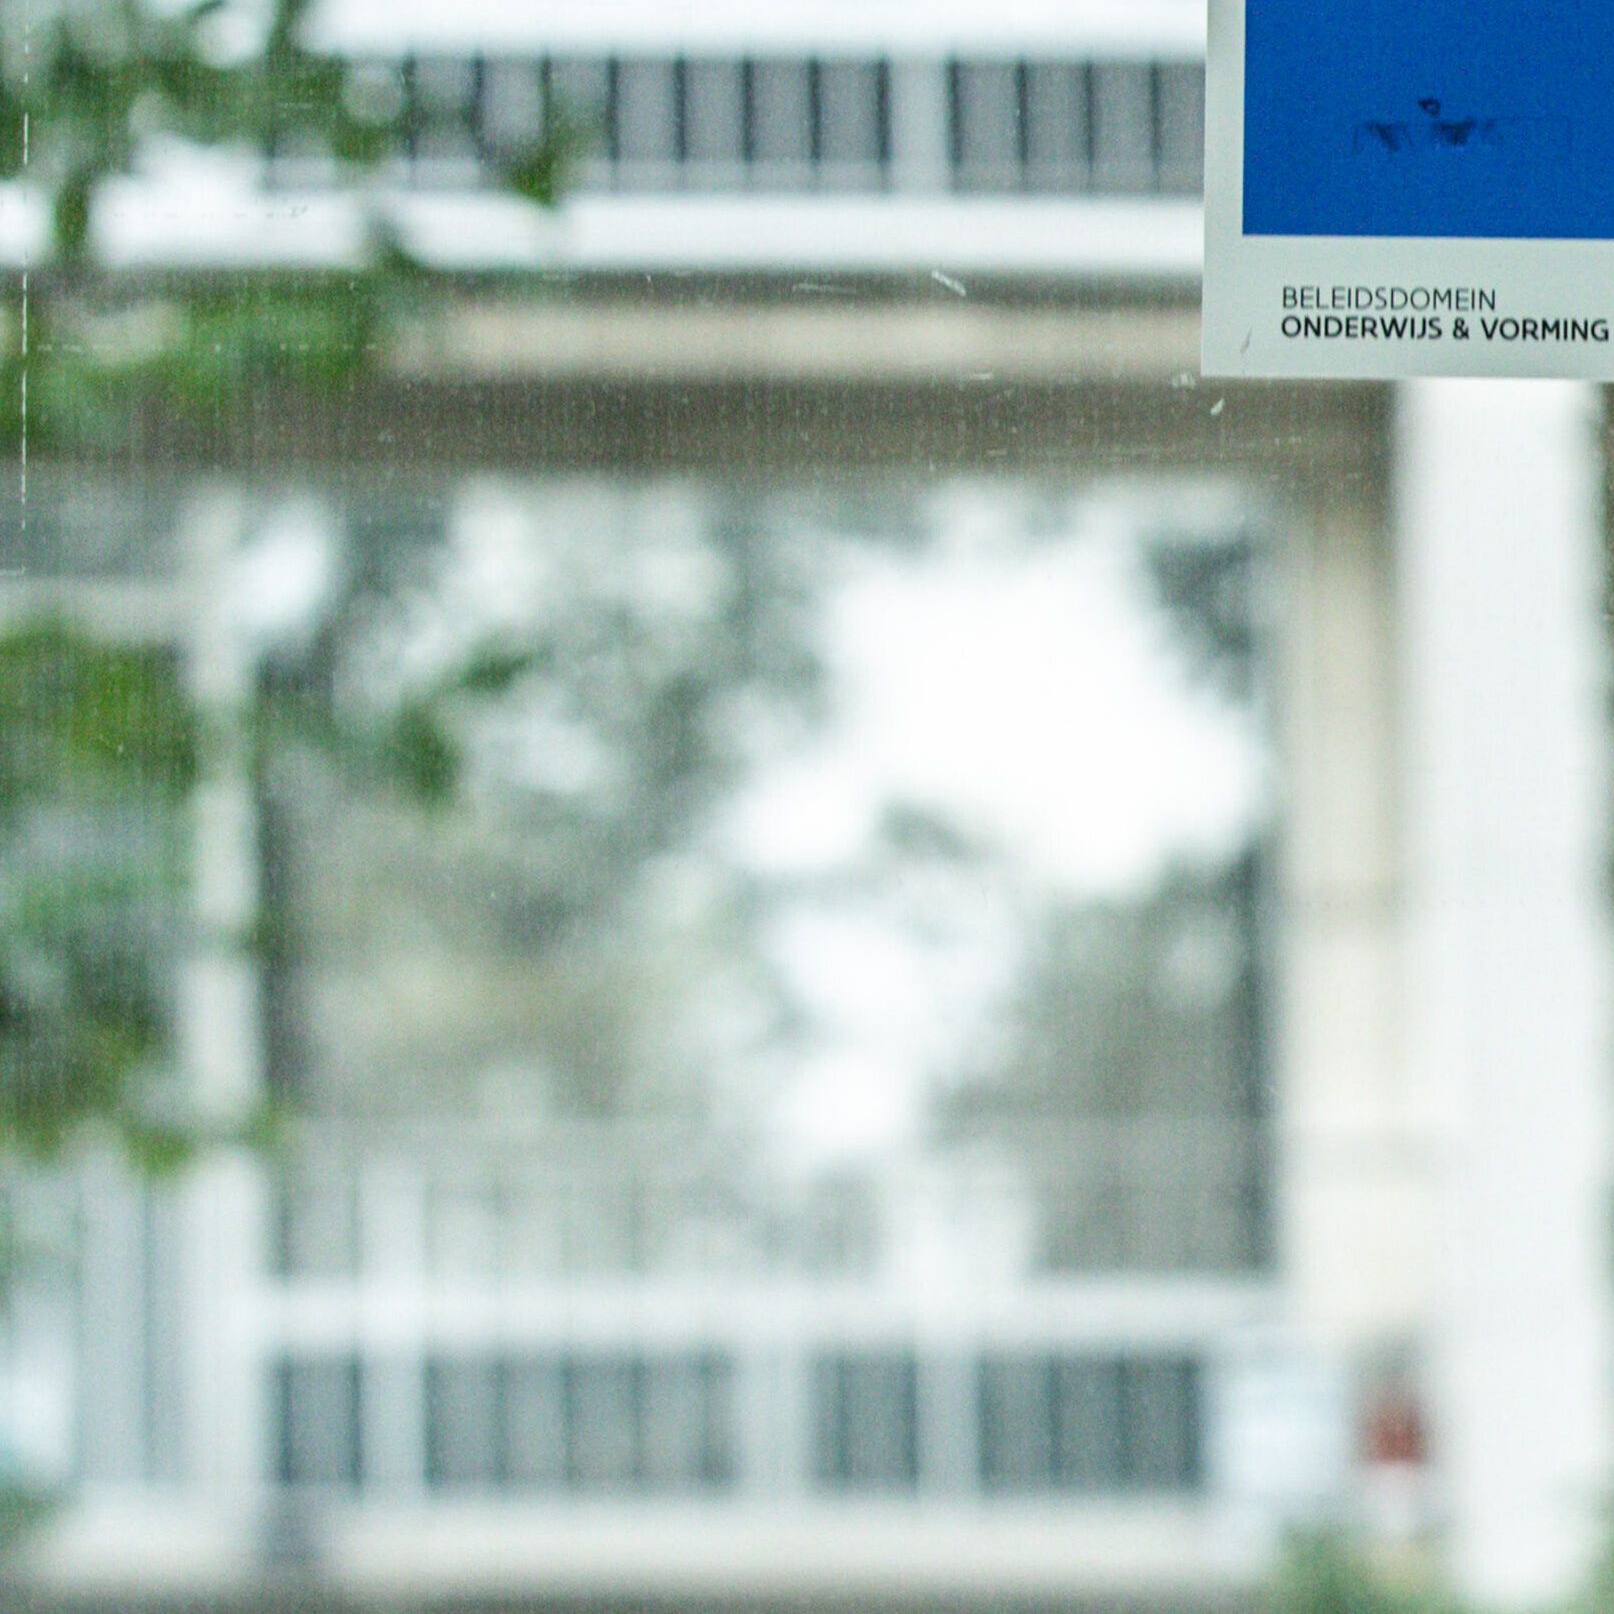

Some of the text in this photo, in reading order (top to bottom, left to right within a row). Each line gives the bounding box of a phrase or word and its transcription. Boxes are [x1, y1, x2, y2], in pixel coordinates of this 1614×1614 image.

[1281, 285, 1498, 312] BELEIDSDOMEIN
[1280, 314, 1611, 343] ONDERWIJS & VORMING
